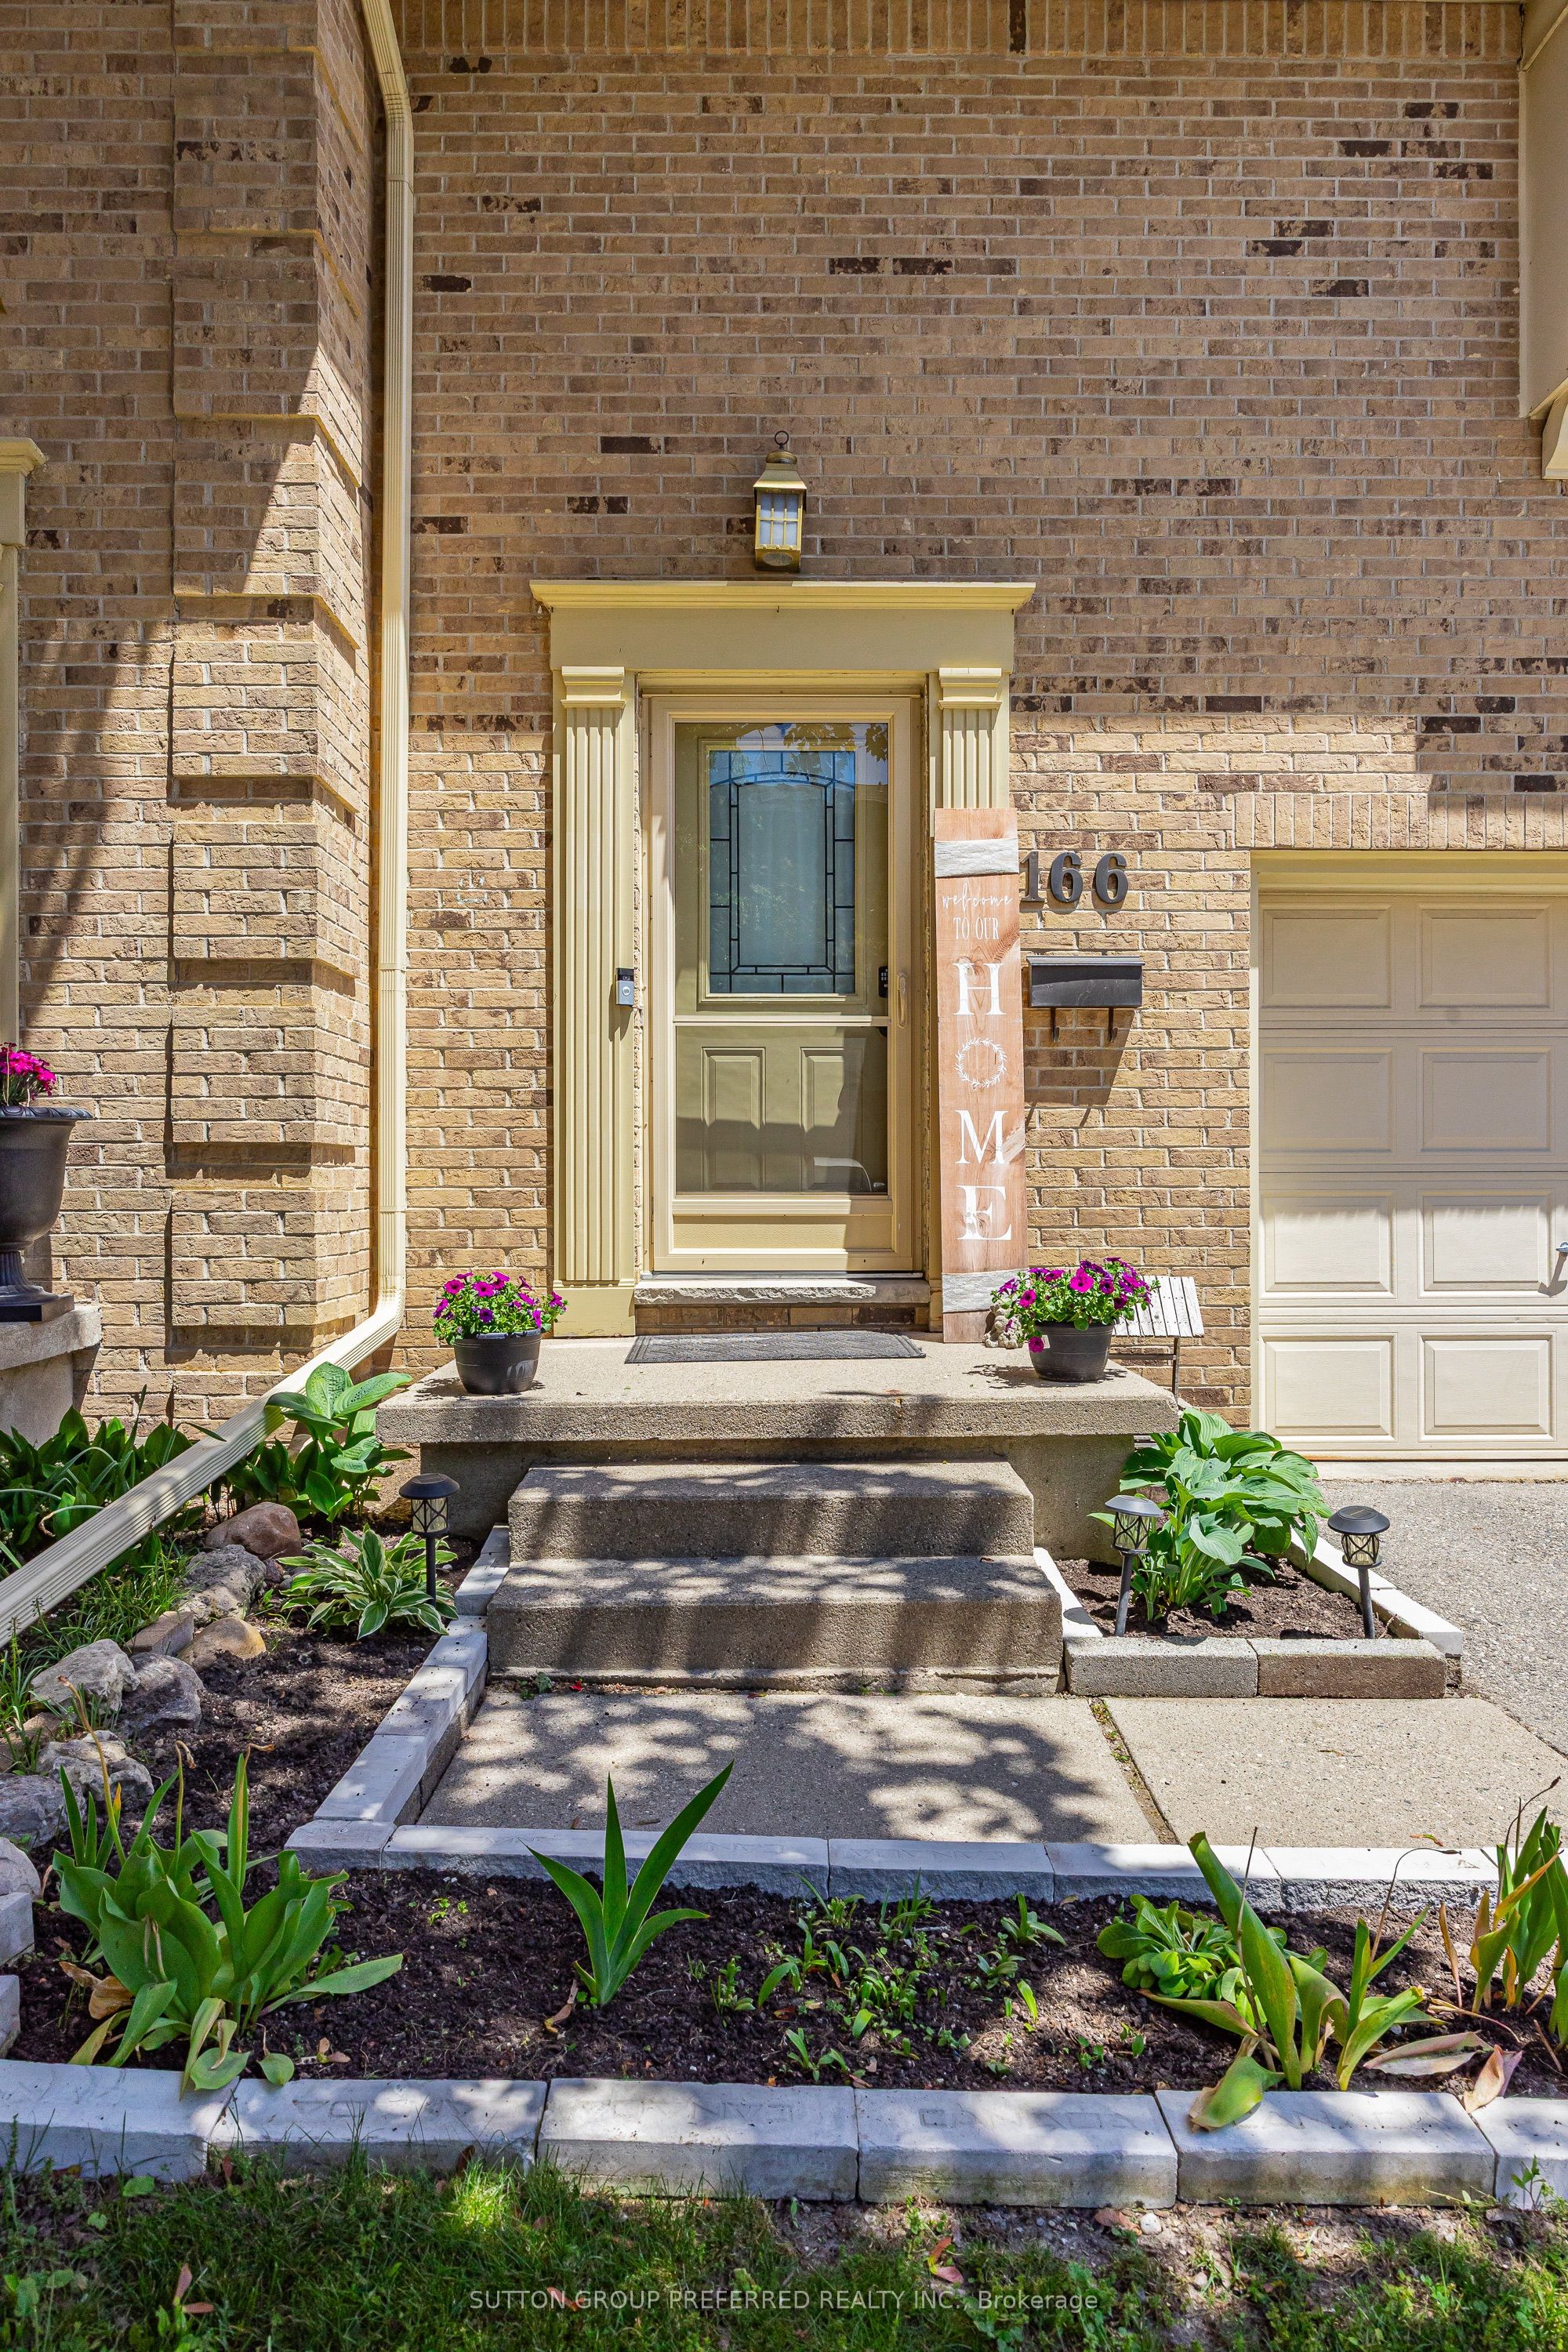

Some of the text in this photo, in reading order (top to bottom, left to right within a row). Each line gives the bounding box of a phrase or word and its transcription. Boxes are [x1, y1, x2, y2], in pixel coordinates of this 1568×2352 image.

[1020, 851, 1129, 903] 166
[942, 883, 1013, 912] welcome
[953, 917, 1000, 939] TO OUR
